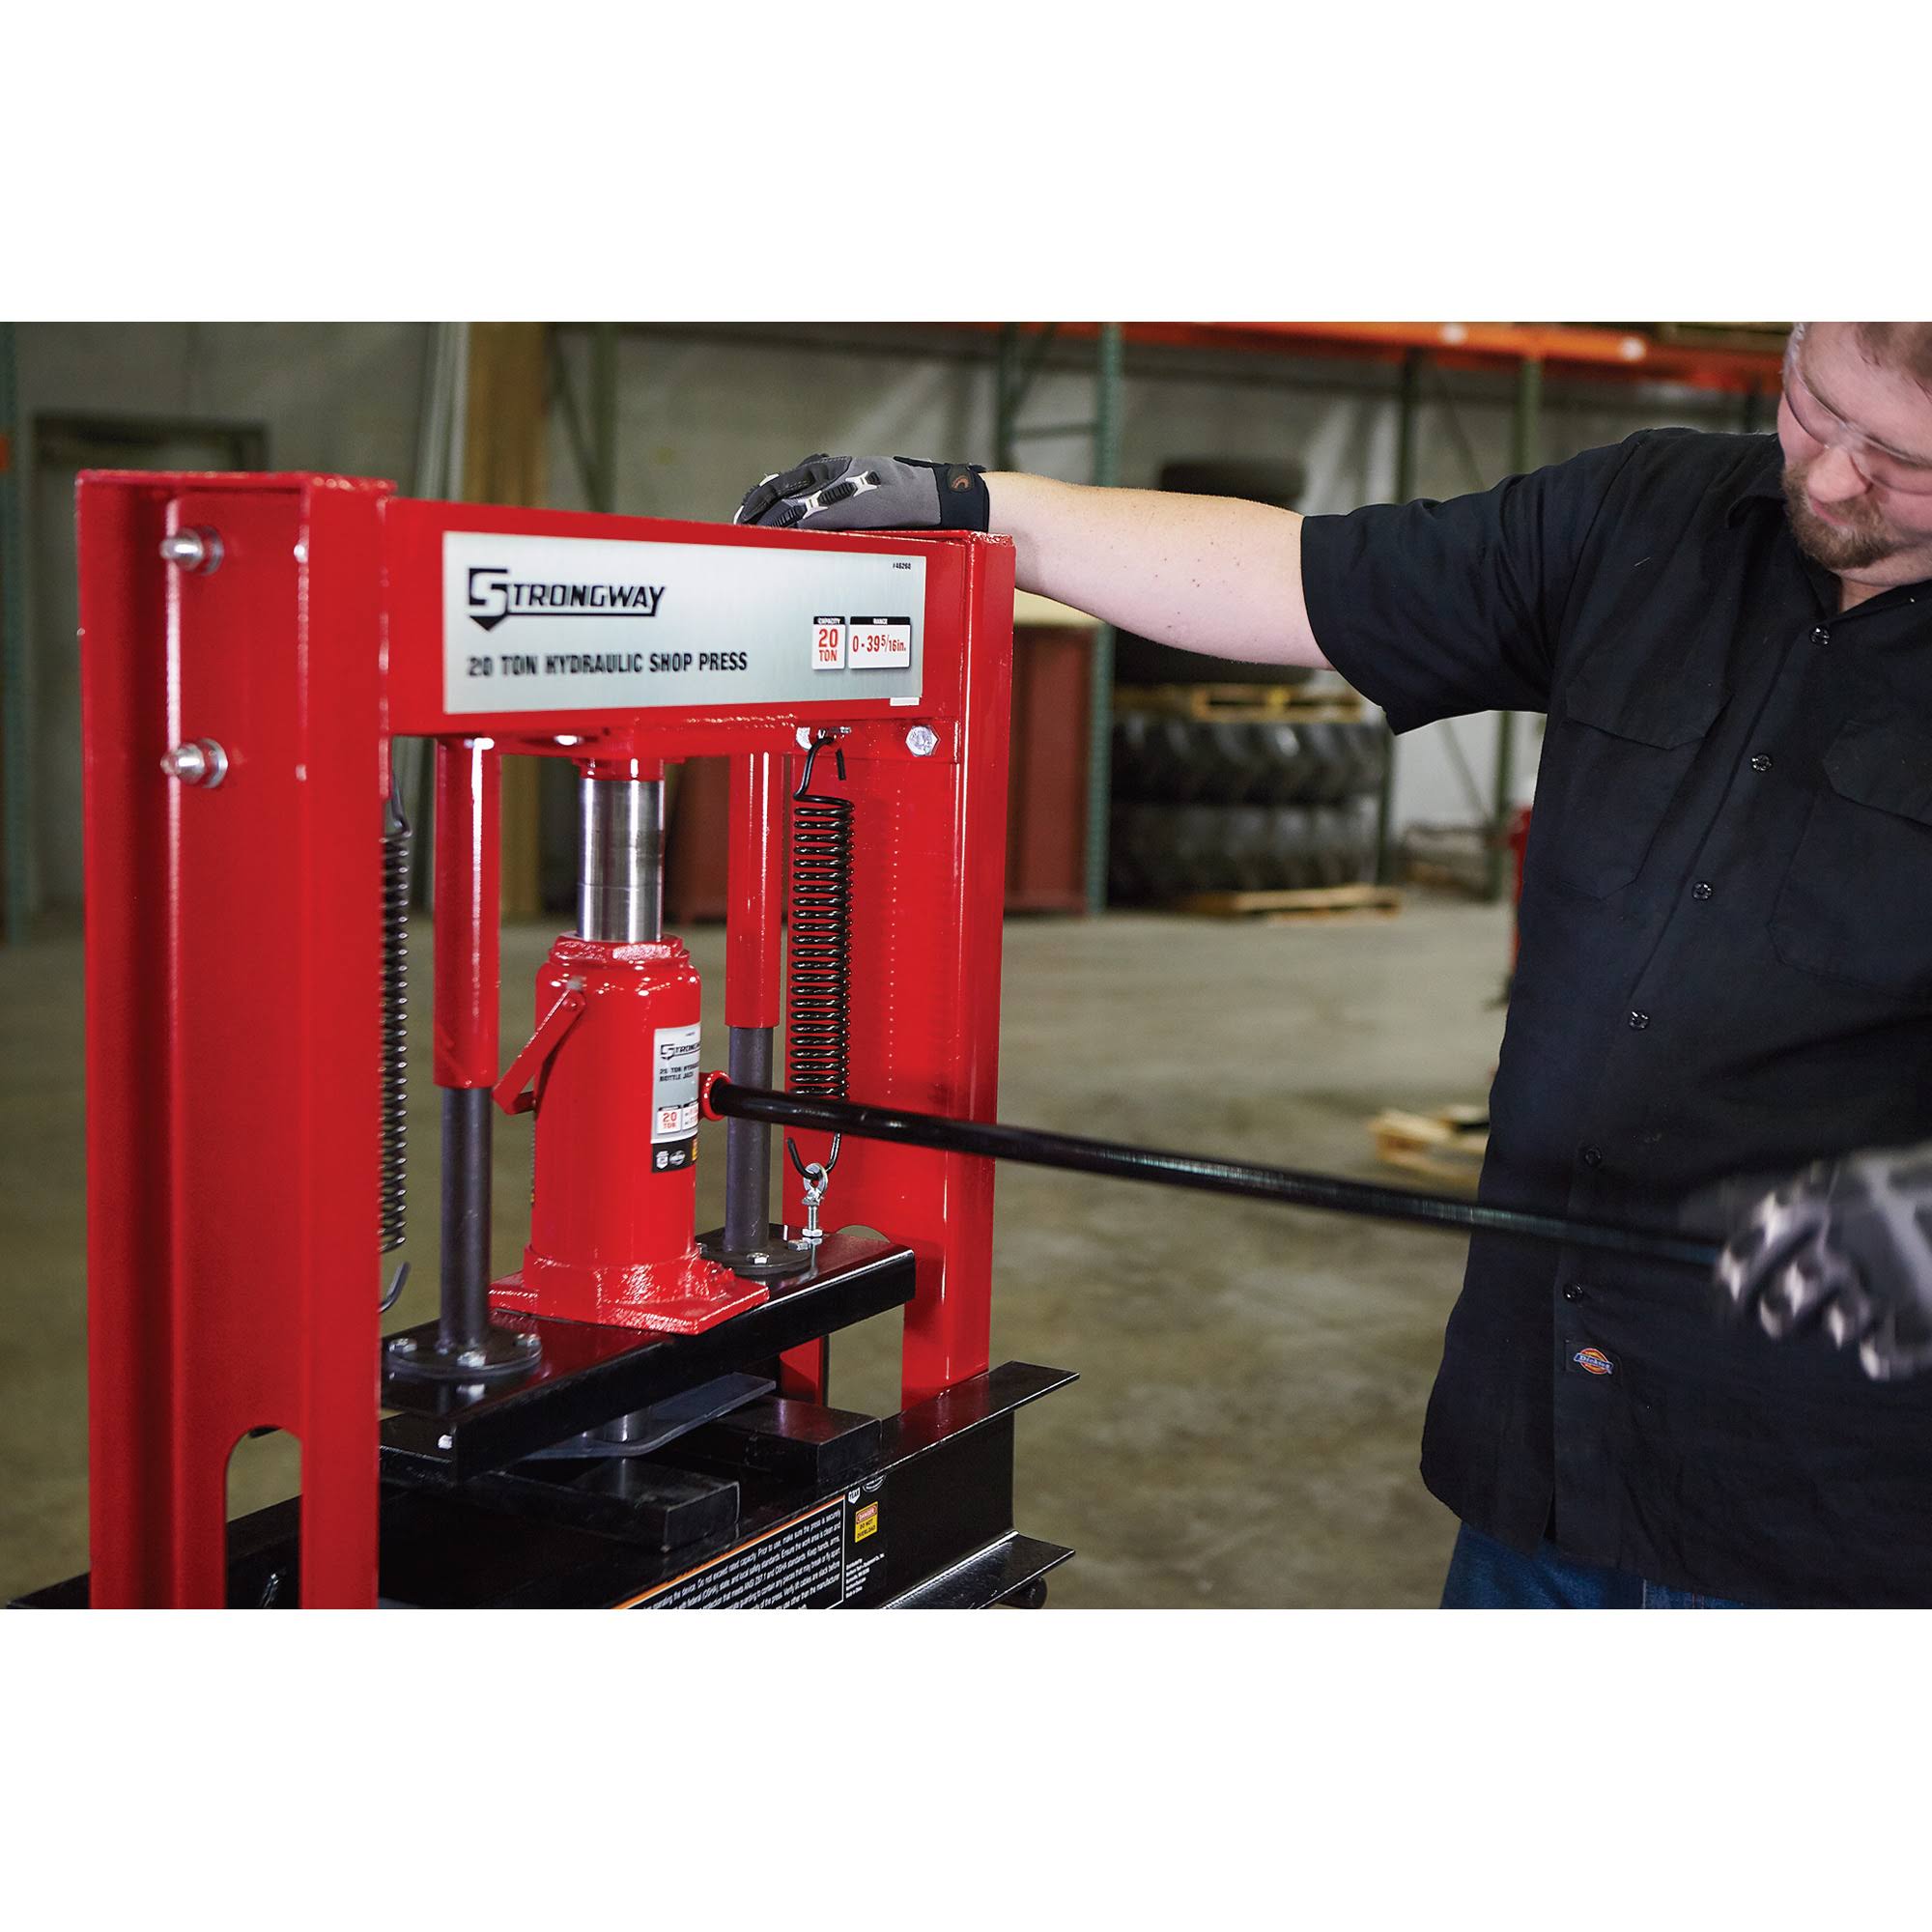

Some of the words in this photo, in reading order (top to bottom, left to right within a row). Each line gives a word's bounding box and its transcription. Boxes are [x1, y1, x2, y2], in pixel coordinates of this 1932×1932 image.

[469, 567, 666, 631] STRONGWAY
[818, 628, 838, 648] 20
[468, 656, 493, 677] 20
[501, 654, 538, 676] TON
[546, 652, 643, 675] HYDRAULIC
[649, 651, 693, 673] SHOP
[698, 650, 749, 672] PRESS
[818, 650, 838, 663] TON
[663, 1112, 676, 1122] 20
